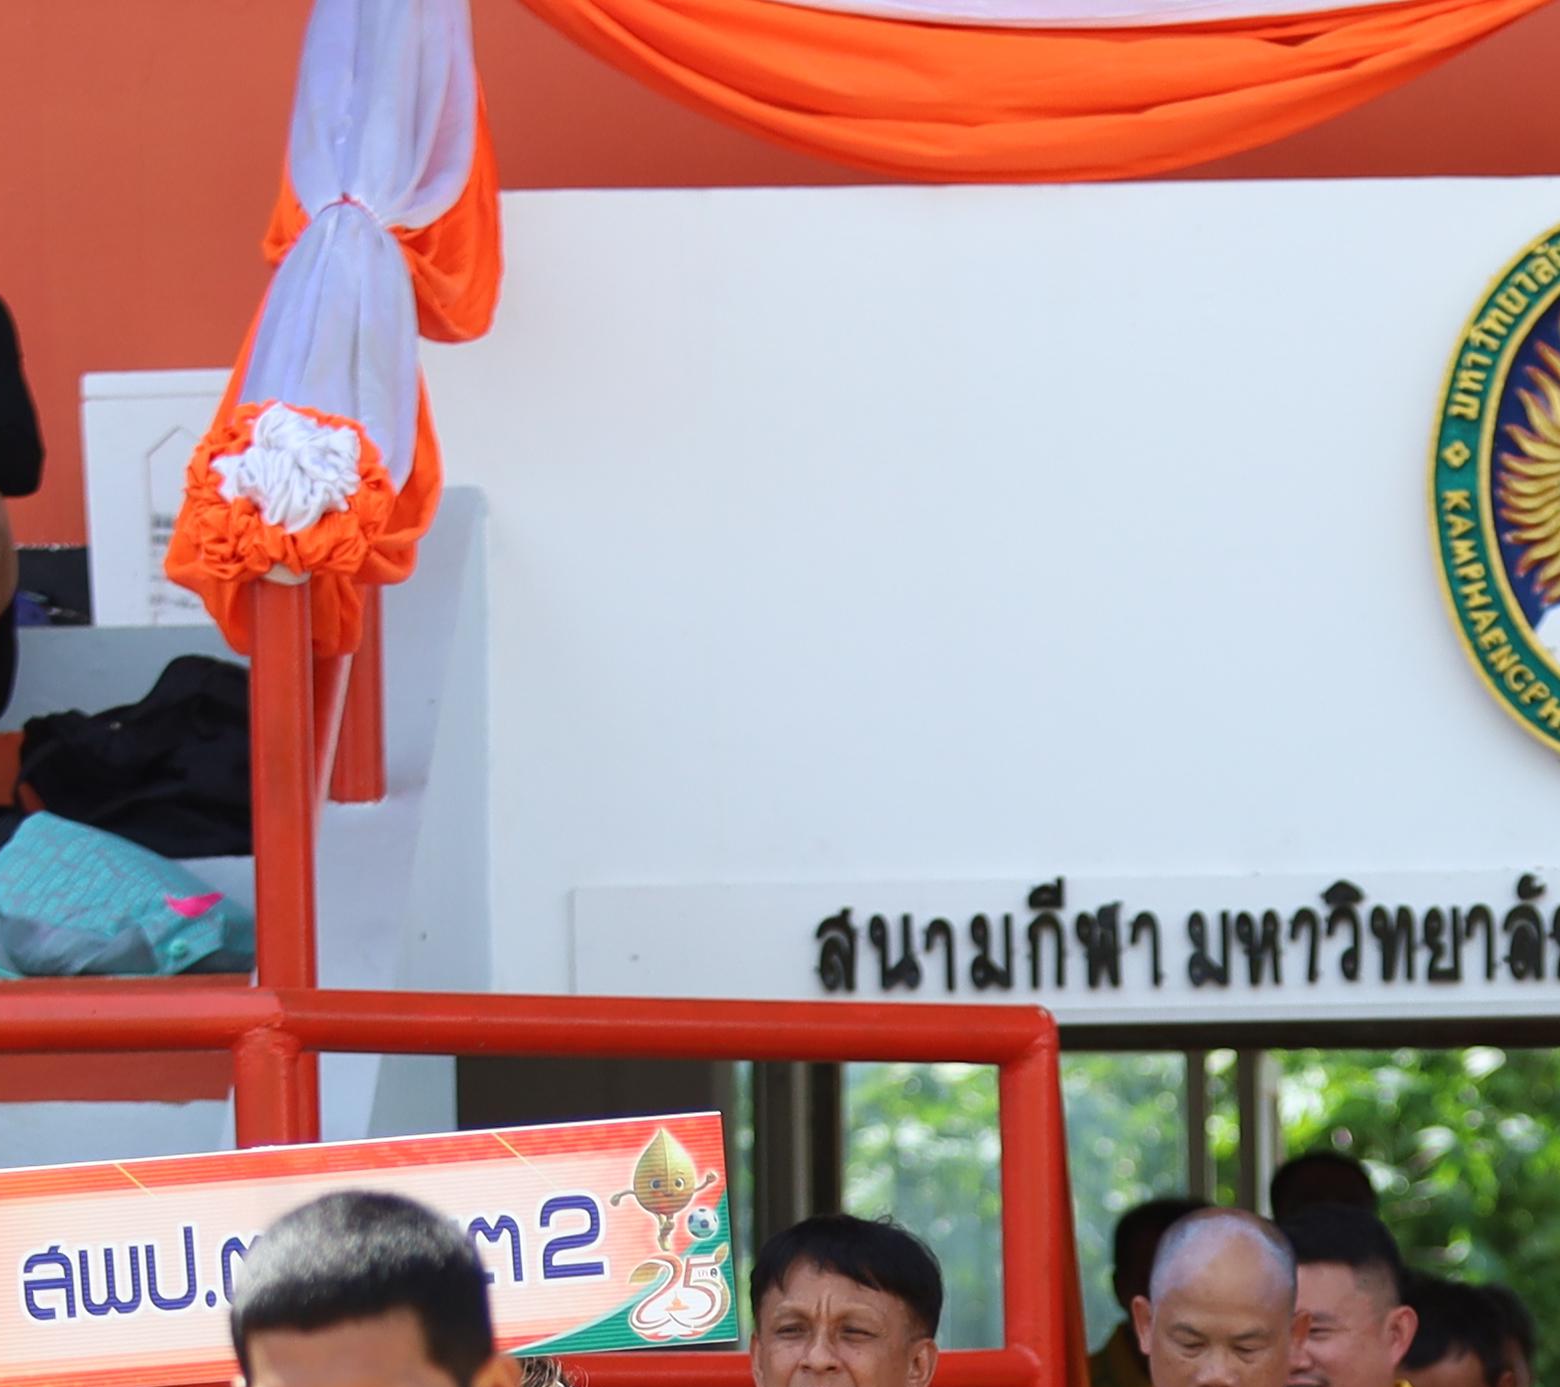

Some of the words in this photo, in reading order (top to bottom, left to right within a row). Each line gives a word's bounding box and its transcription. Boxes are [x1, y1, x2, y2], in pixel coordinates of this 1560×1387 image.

[814, 876, 1166, 991] สนามกีฬา
[540, 1195, 604, 1279] 2
